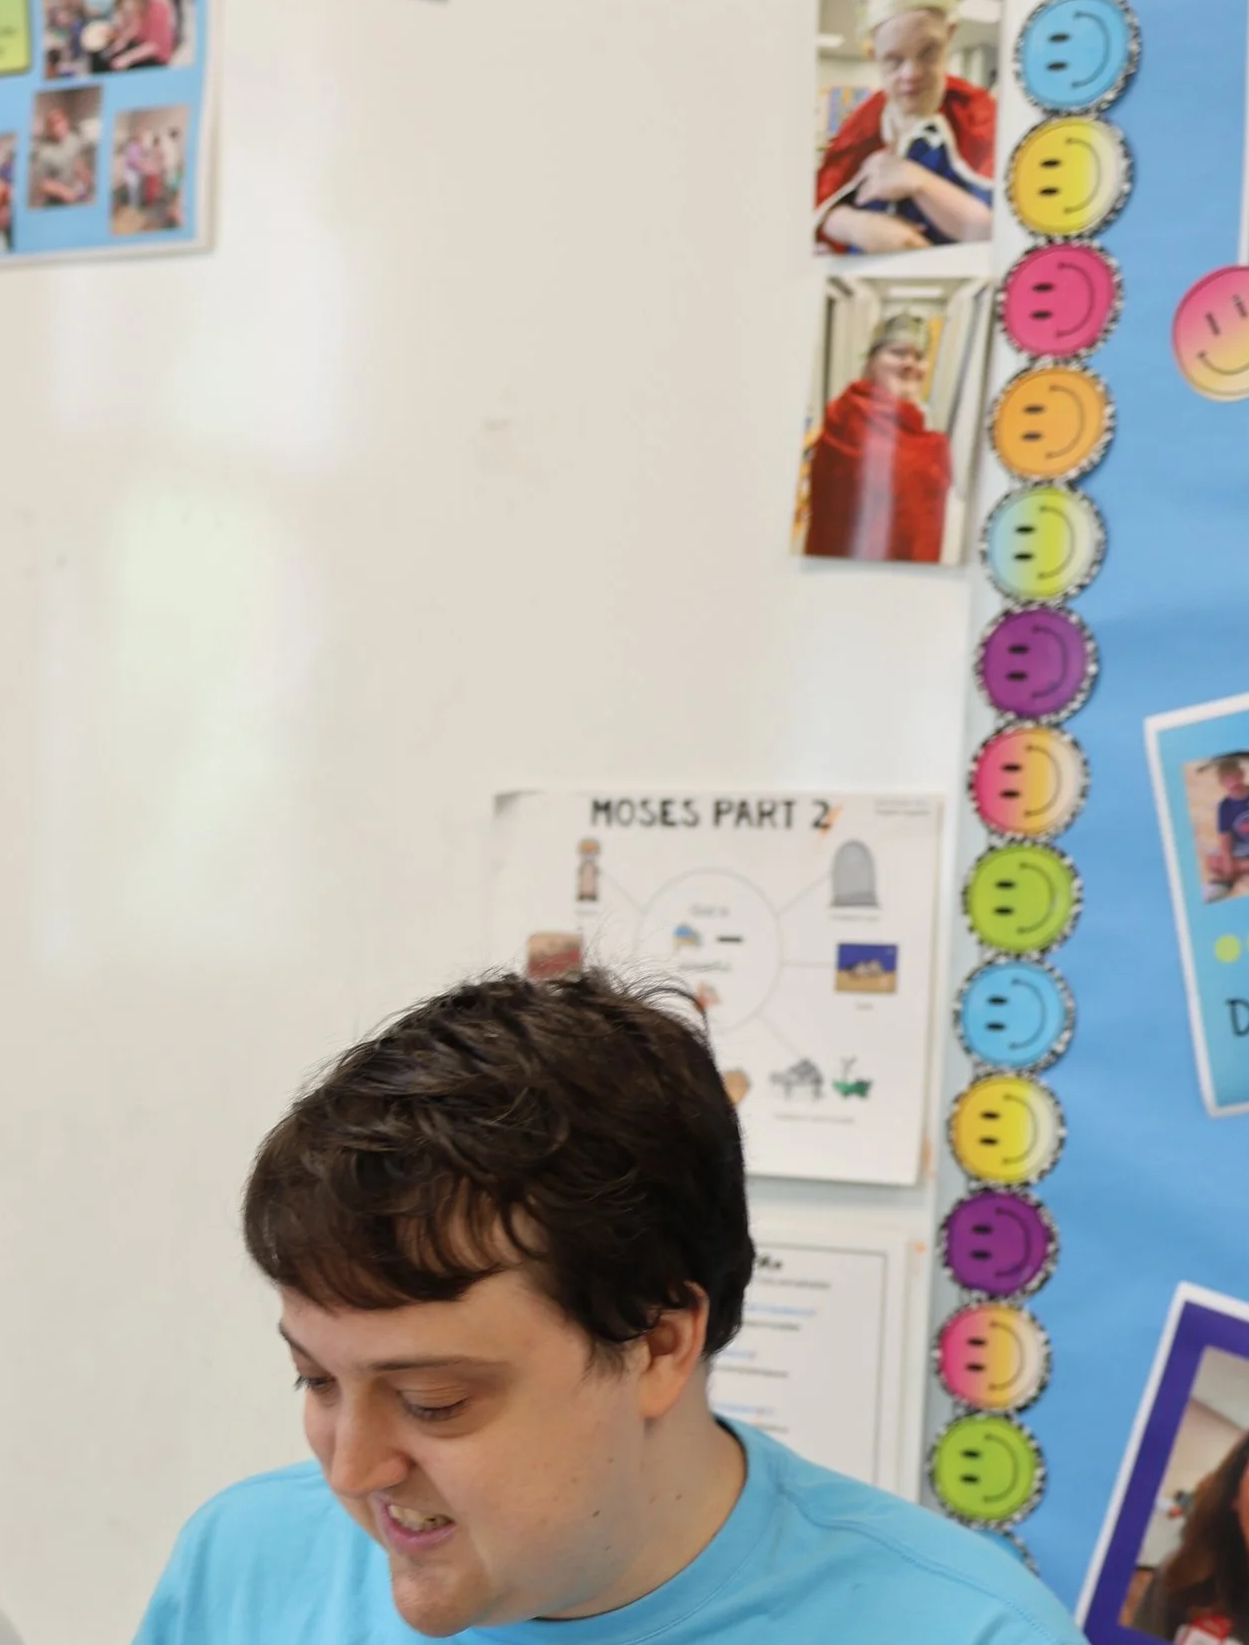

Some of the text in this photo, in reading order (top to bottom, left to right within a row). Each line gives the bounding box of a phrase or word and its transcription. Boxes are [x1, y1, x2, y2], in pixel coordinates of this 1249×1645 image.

[591, 798, 832, 830] MOSES PART 2
